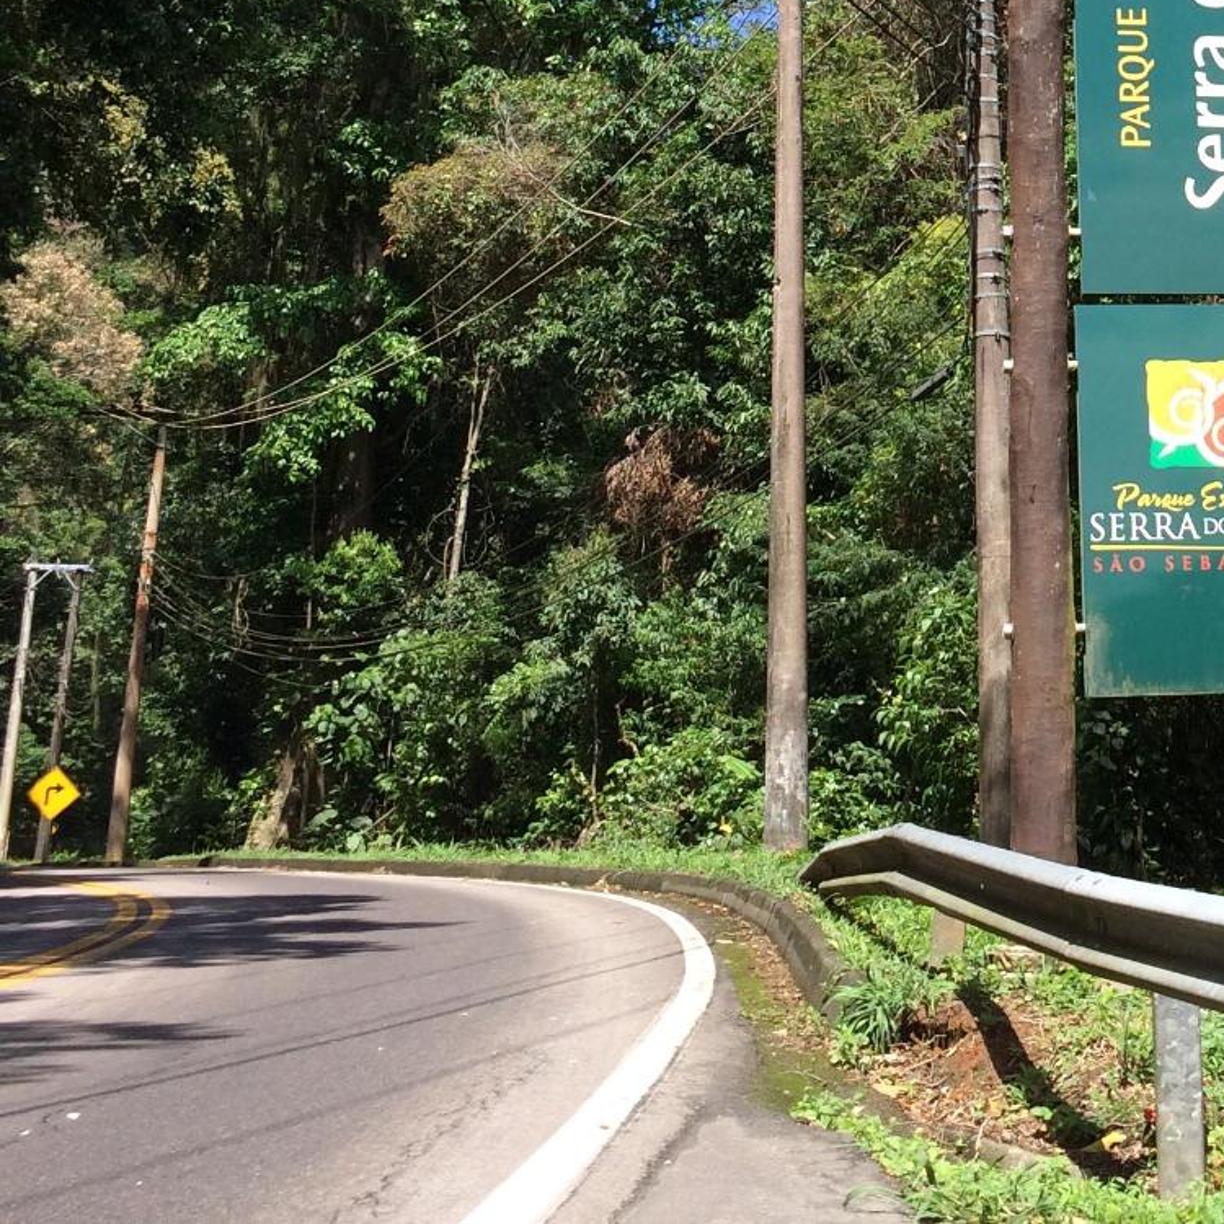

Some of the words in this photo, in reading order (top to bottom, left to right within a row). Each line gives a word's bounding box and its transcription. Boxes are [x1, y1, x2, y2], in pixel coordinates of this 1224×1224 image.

[1116, 8, 1155, 148] PARQUE
[1112, 482, 1196, 511] Parque
[1089, 511, 1201, 543] SERRA
[1092, 552, 1146, 573] SÃO
